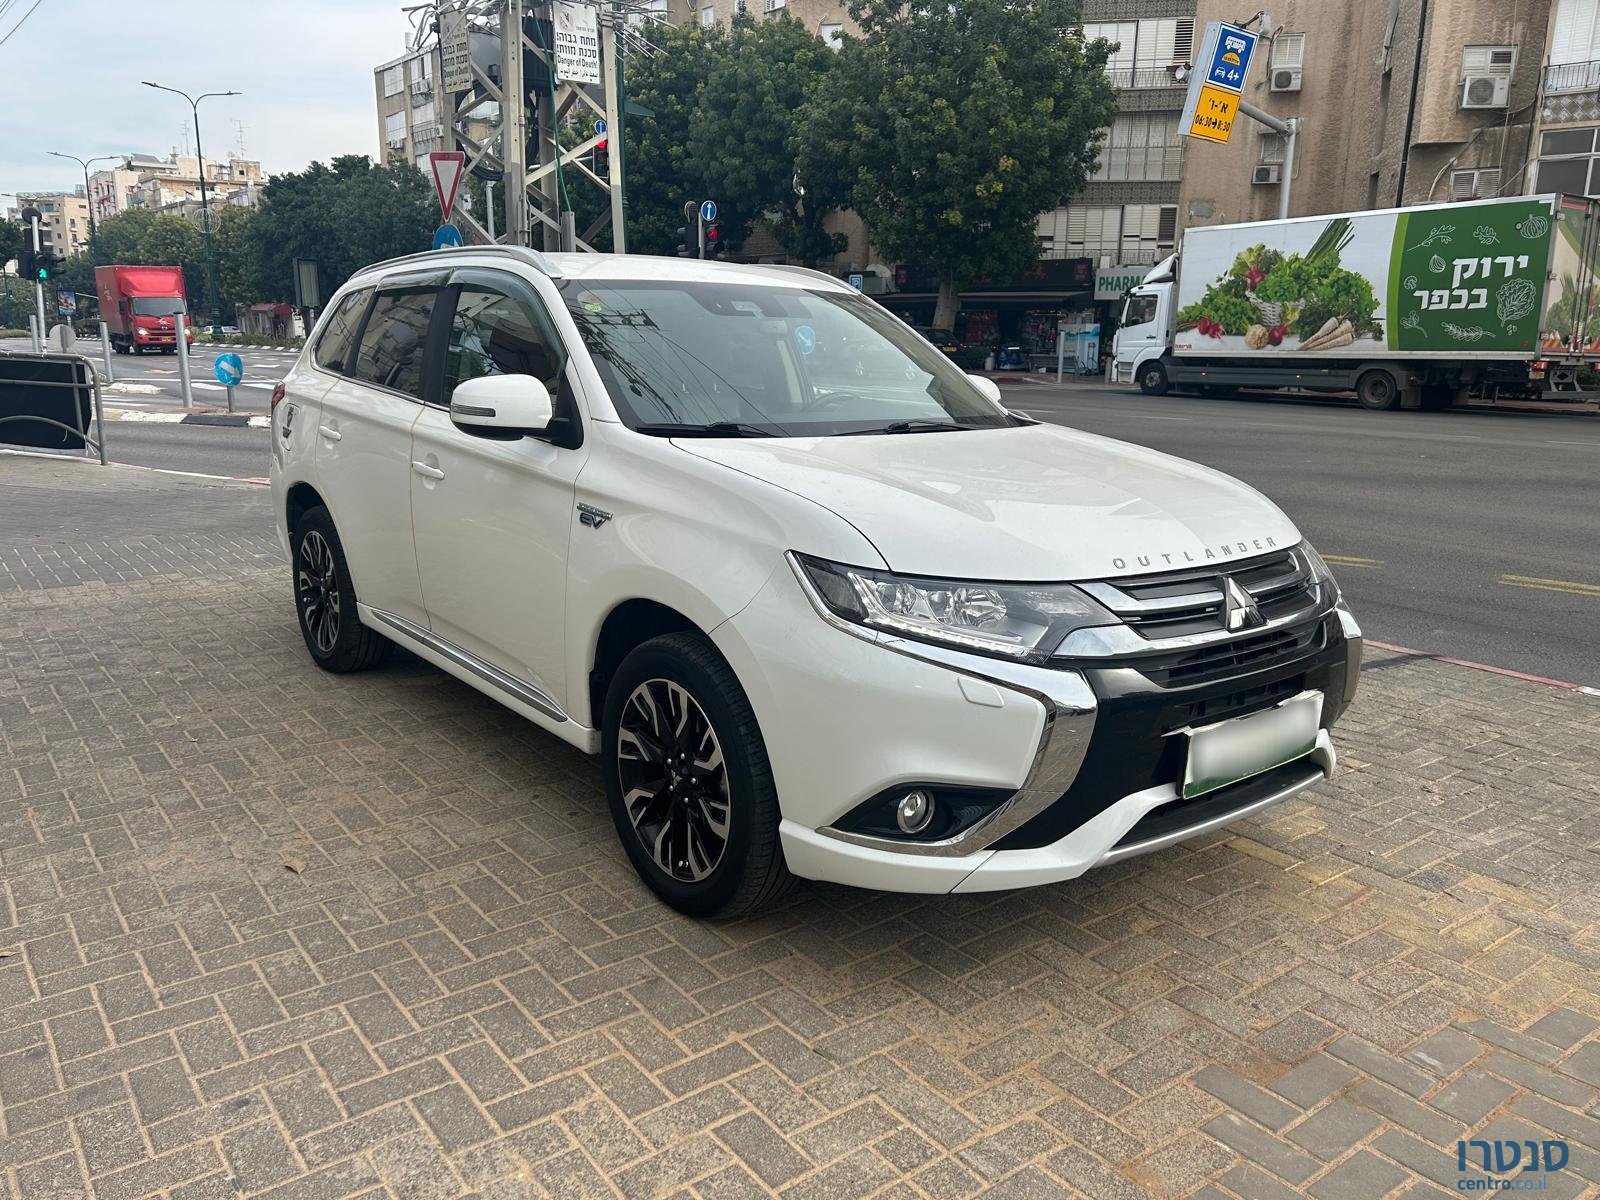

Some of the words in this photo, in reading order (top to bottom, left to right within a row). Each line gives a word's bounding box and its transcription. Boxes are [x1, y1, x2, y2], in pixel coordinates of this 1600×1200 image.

[579, 35, 597, 47] מתח
[578, 47, 598, 59] סכנת
[557, 55, 575, 67] Danger
[576, 58, 581, 66] of
[1227, 69, 1240, 81] 4+
[1195, 114, 1213, 128] 06:30
[1451, 254, 1530, 289] ירוק
[1098, 275, 1145, 292] PHARM
[1412, 288, 1489, 311] בכפר
[579, 511, 608, 530] EV
[1111, 535, 1278, 571] OUTLANDER
